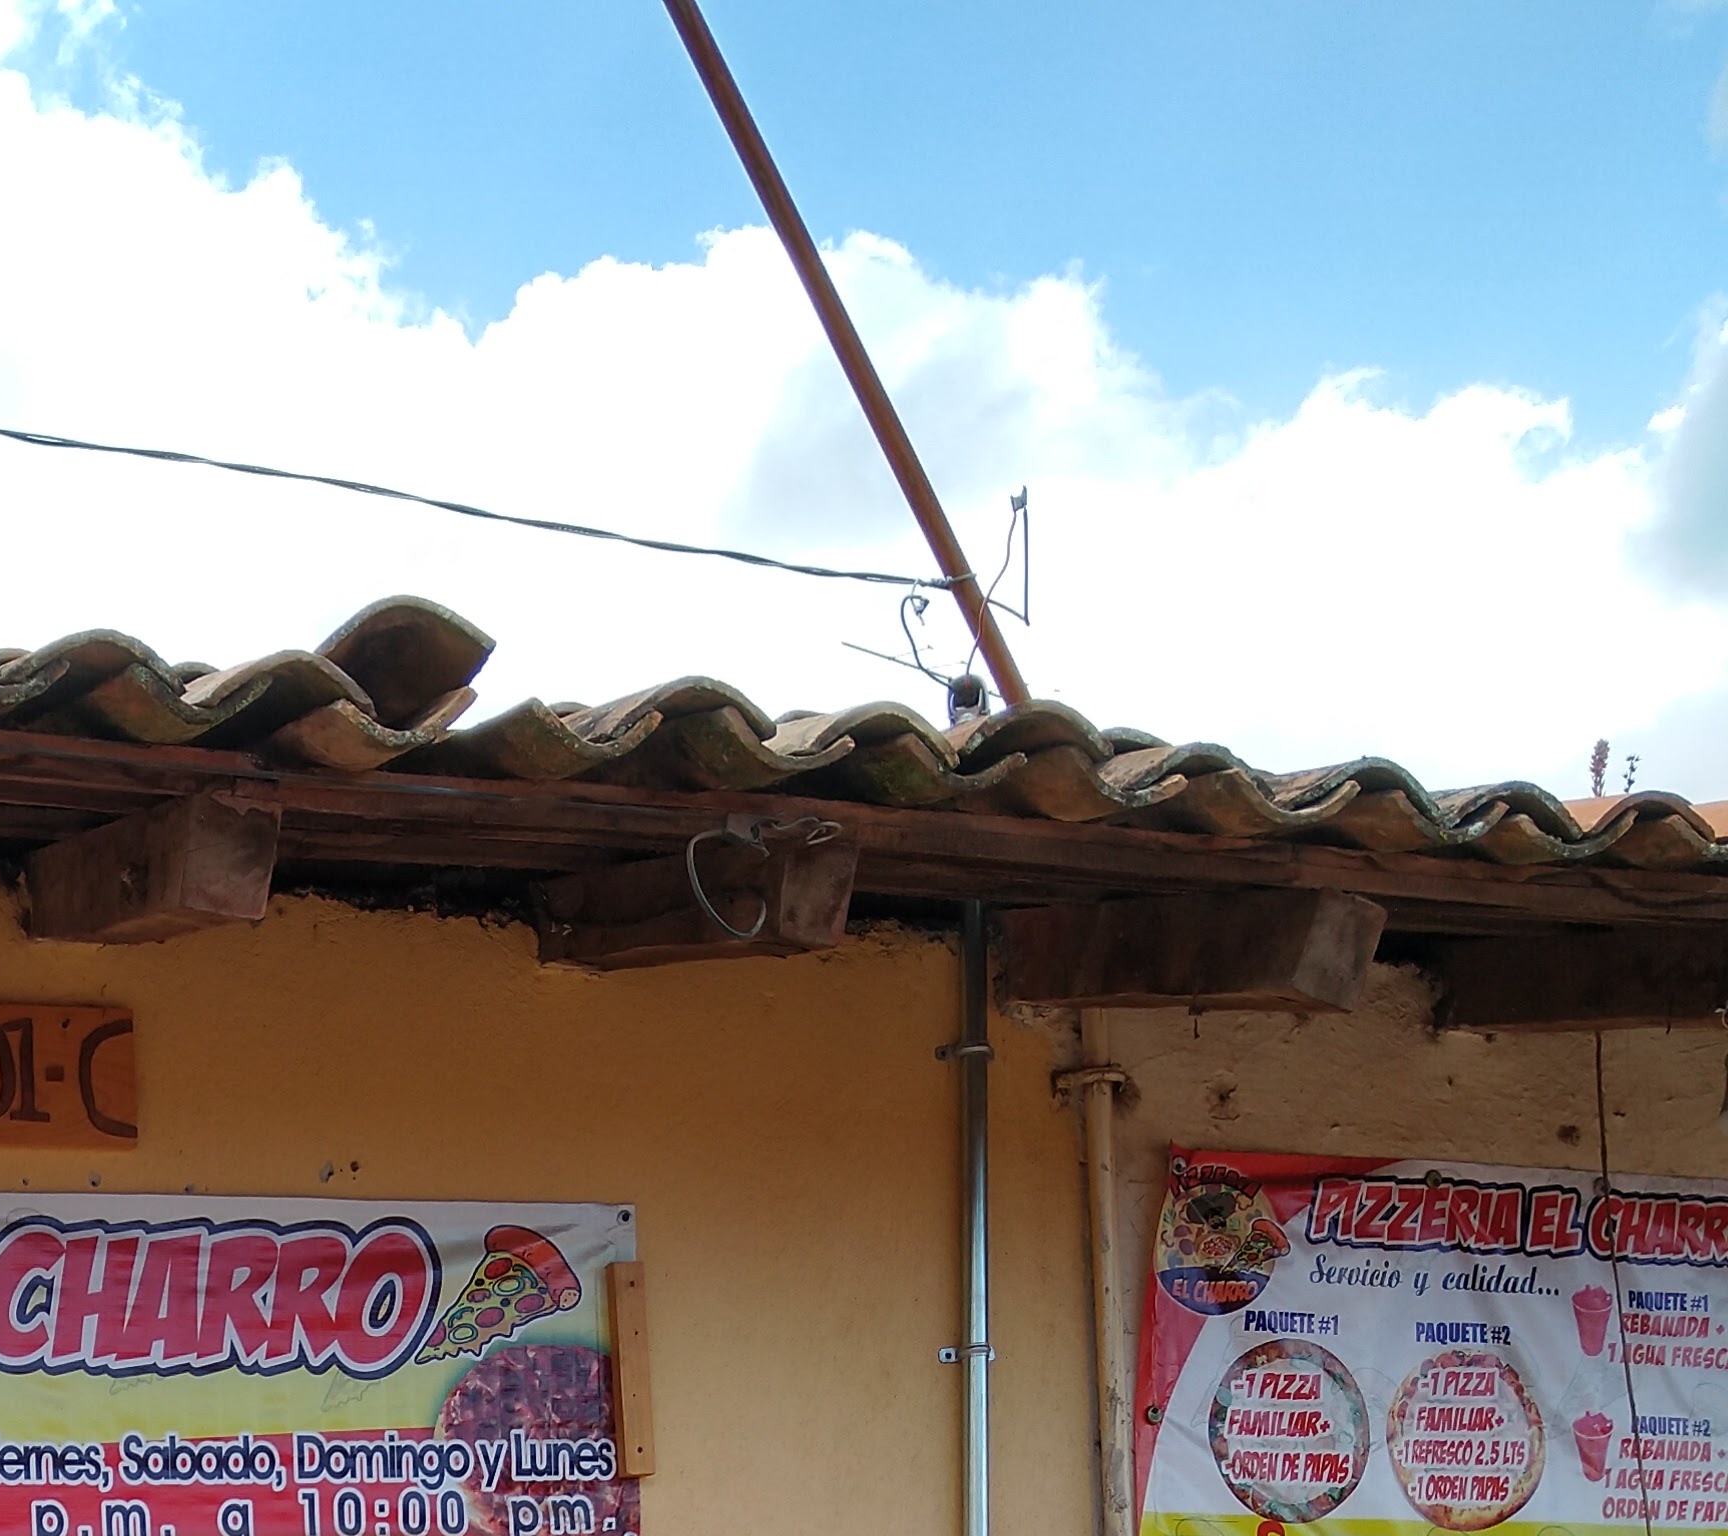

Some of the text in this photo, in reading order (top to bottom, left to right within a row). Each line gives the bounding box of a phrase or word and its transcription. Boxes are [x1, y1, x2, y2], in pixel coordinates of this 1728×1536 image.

[1305, 1175, 1525, 1255] PIZZERIA
[1523, 1185, 1584, 1258] EL
[1309, 1254, 1560, 1296] Servicio y calidad...
[1172, 1279, 1259, 1304] EL CHARRO
[1628, 1290, 1708, 1312] PAQUETE #1
[1244, 1310, 1339, 1335] PAQUETE #1
[1415, 1322, 1511, 1346] PAQUETE #2
[1621, 1312, 1710, 1338] REBANADA
[1608, 1343, 1617, 1363] 1
[1259, 1374, 1321, 1400] PIZZA
[1444, 1371, 1496, 1396] PIZZA
[1227, 1409, 1331, 1437] FAMILIAR+
[1416, 1407, 1504, 1432] FAMILIAR+
[1693, 1419, 1711, 1437] #2
[122, 1433, 286, 1489] Sabado,
[293, 1432, 471, 1490] Domingo
[477, 1439, 507, 1490] y
[511, 1430, 616, 1481] Lunes
[1412, 1440, 1472, 1466] REFRESCO
[1475, 1440, 1499, 1465] 2.5
[1502, 1441, 1525, 1466] LTS
[1619, 1438, 1711, 1462] REBANADA
[1283, 1456, 1300, 1481] DE
[1303, 1455, 1350, 1484] PAPAS
[1604, 1468, 1612, 1489] 1
[1615, 1468, 1665, 1491] AGUA
[1425, 1475, 1467, 1501] ORDEN
[1470, 1476, 1509, 1501] PAPAS
[1602, 1496, 1728, 1523] ORDEN DE PAP
